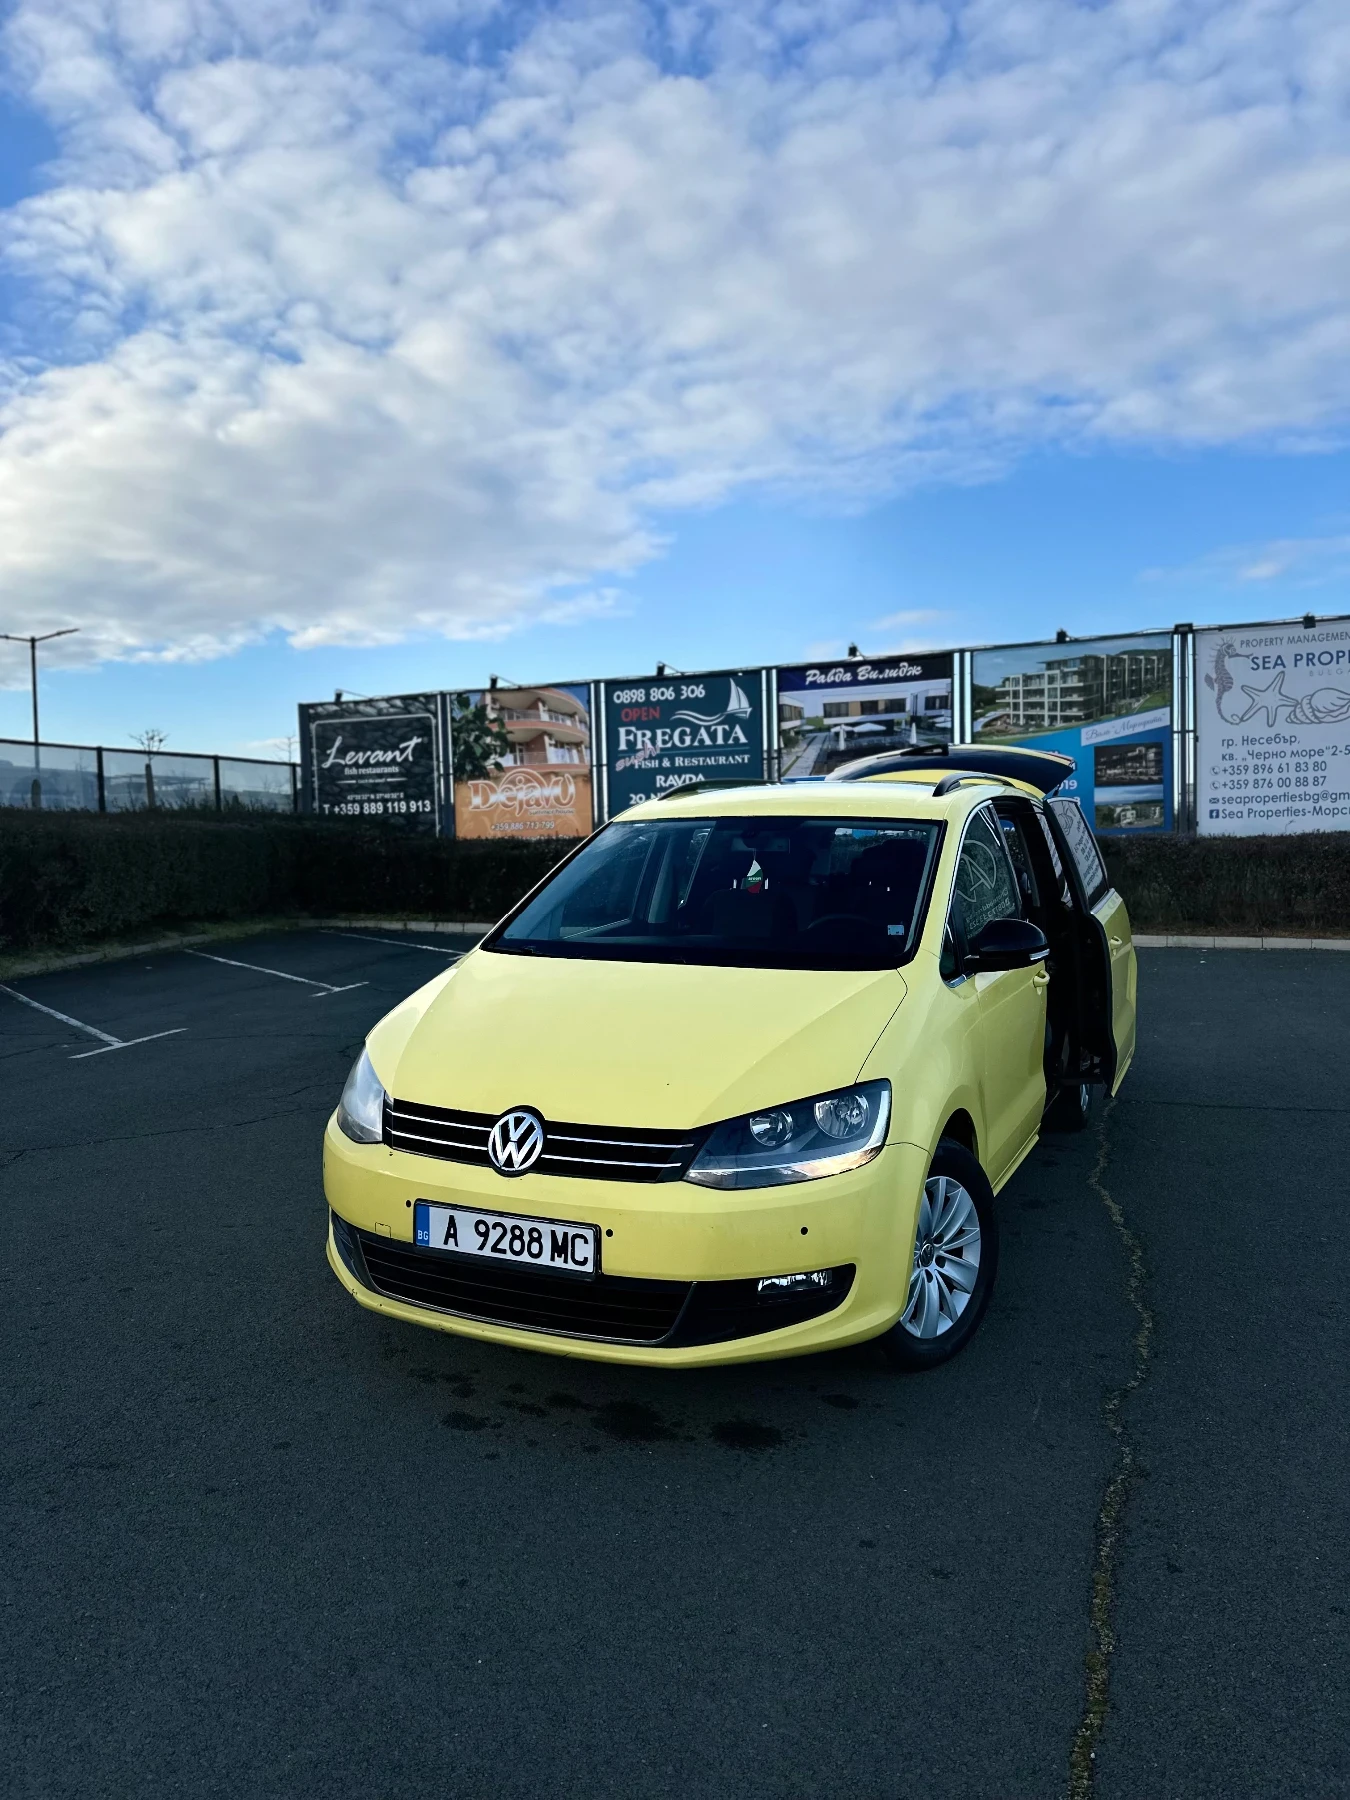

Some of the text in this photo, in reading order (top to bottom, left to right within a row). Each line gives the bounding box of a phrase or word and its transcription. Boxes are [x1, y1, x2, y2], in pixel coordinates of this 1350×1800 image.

[1240, 636, 1284, 648] PROPERTY
[1250, 649, 1350, 671] SEA PROP
[805, 661, 922, 686] Равда Вилидж
[613, 684, 706, 704] 0898 806 306
[621, 706, 660, 722] OPEN
[618, 724, 748, 750] FREGATA
[1221, 734, 1300, 749] гр. Несебър,
[321, 735, 422, 769] Levant
[1221, 753, 1238, 761] кв.
[635, 754, 751, 769] FISH & RESTAURANT
[1221, 760, 1328, 776] +359 896 61 83 80
[344, 766, 399, 775] fish restaurants
[1221, 775, 1327, 790] +359 876 00 88 87
[629, 793, 646, 805] 20
[323, 799, 432, 815] T +359 889 119 913
[1221, 808, 1244, 819] Sea
[1247, 805, 1350, 820] Properties-Морс
[417, 1228, 429, 1241] BG
[443, 1214, 589, 1267] A 9288 MC
